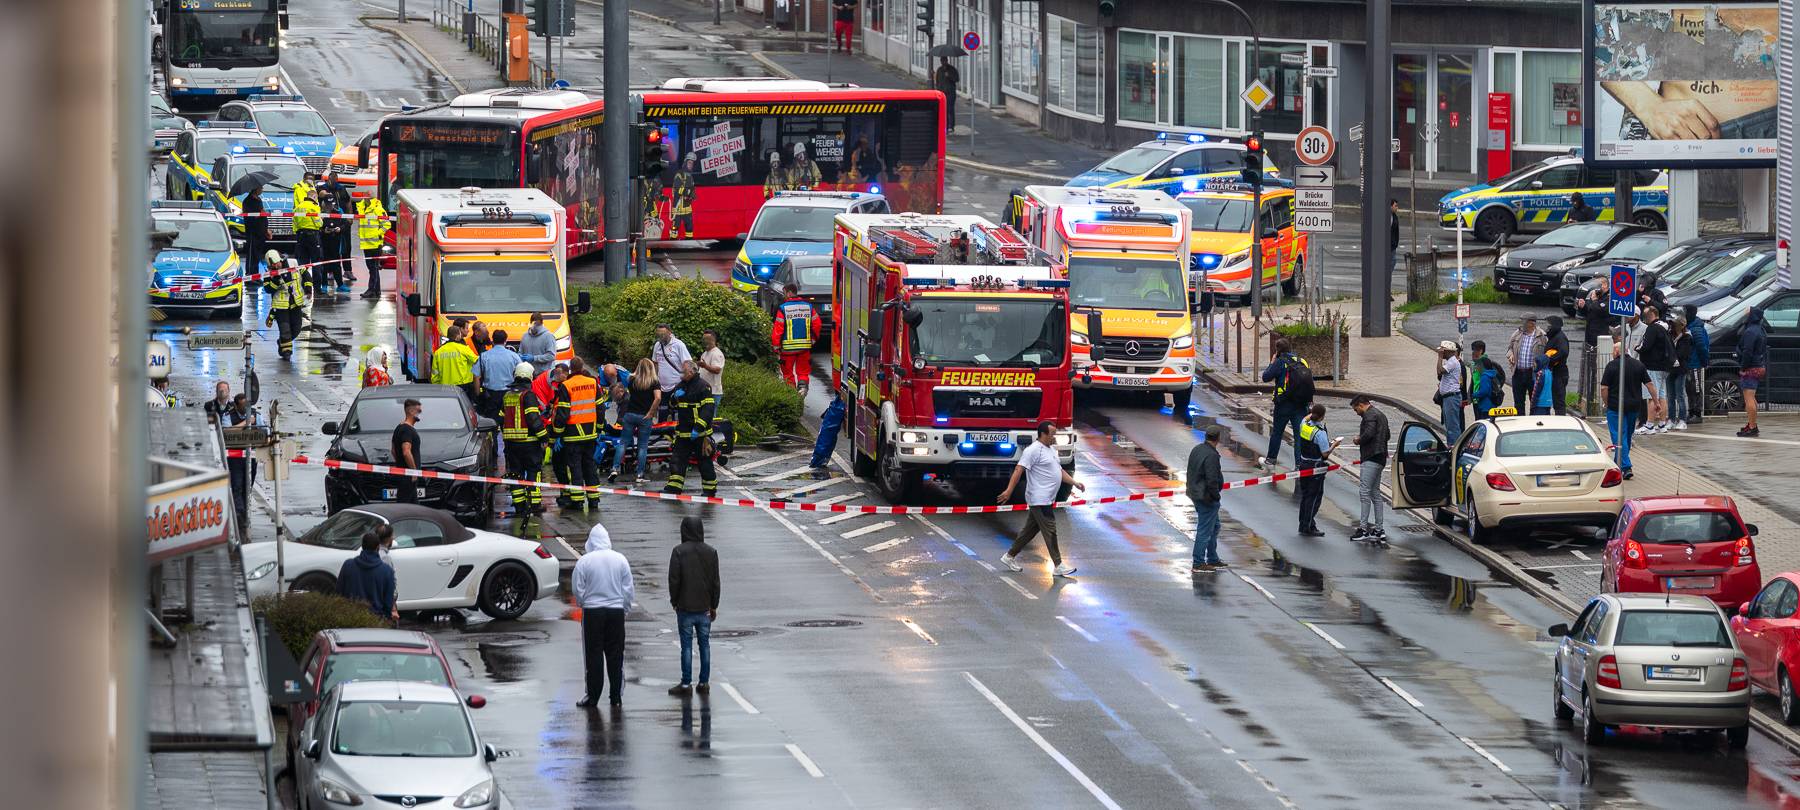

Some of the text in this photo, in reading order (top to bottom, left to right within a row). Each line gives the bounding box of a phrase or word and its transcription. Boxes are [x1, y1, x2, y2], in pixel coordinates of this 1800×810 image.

[1690, 81, 1723, 94] dich.
[667, 106, 769, 116] MACH MIT BEI DER FEUERWEHR
[715, 123, 729, 134] WIR
[722, 138, 743, 154] DEIN
[816, 148, 844, 156] WEHREN
[703, 155, 731, 171] LEBEN
[1205, 183, 1240, 191] NOTARZT
[1530, 199, 1563, 207] POLIZEI
[1611, 299, 1633, 312] TAXI
[194, 336, 239, 345] Ackerstraße
[150, 354, 166, 367] Alt
[941, 371, 1036, 386] FEUERWEHR
[969, 398, 1006, 406] MAN
